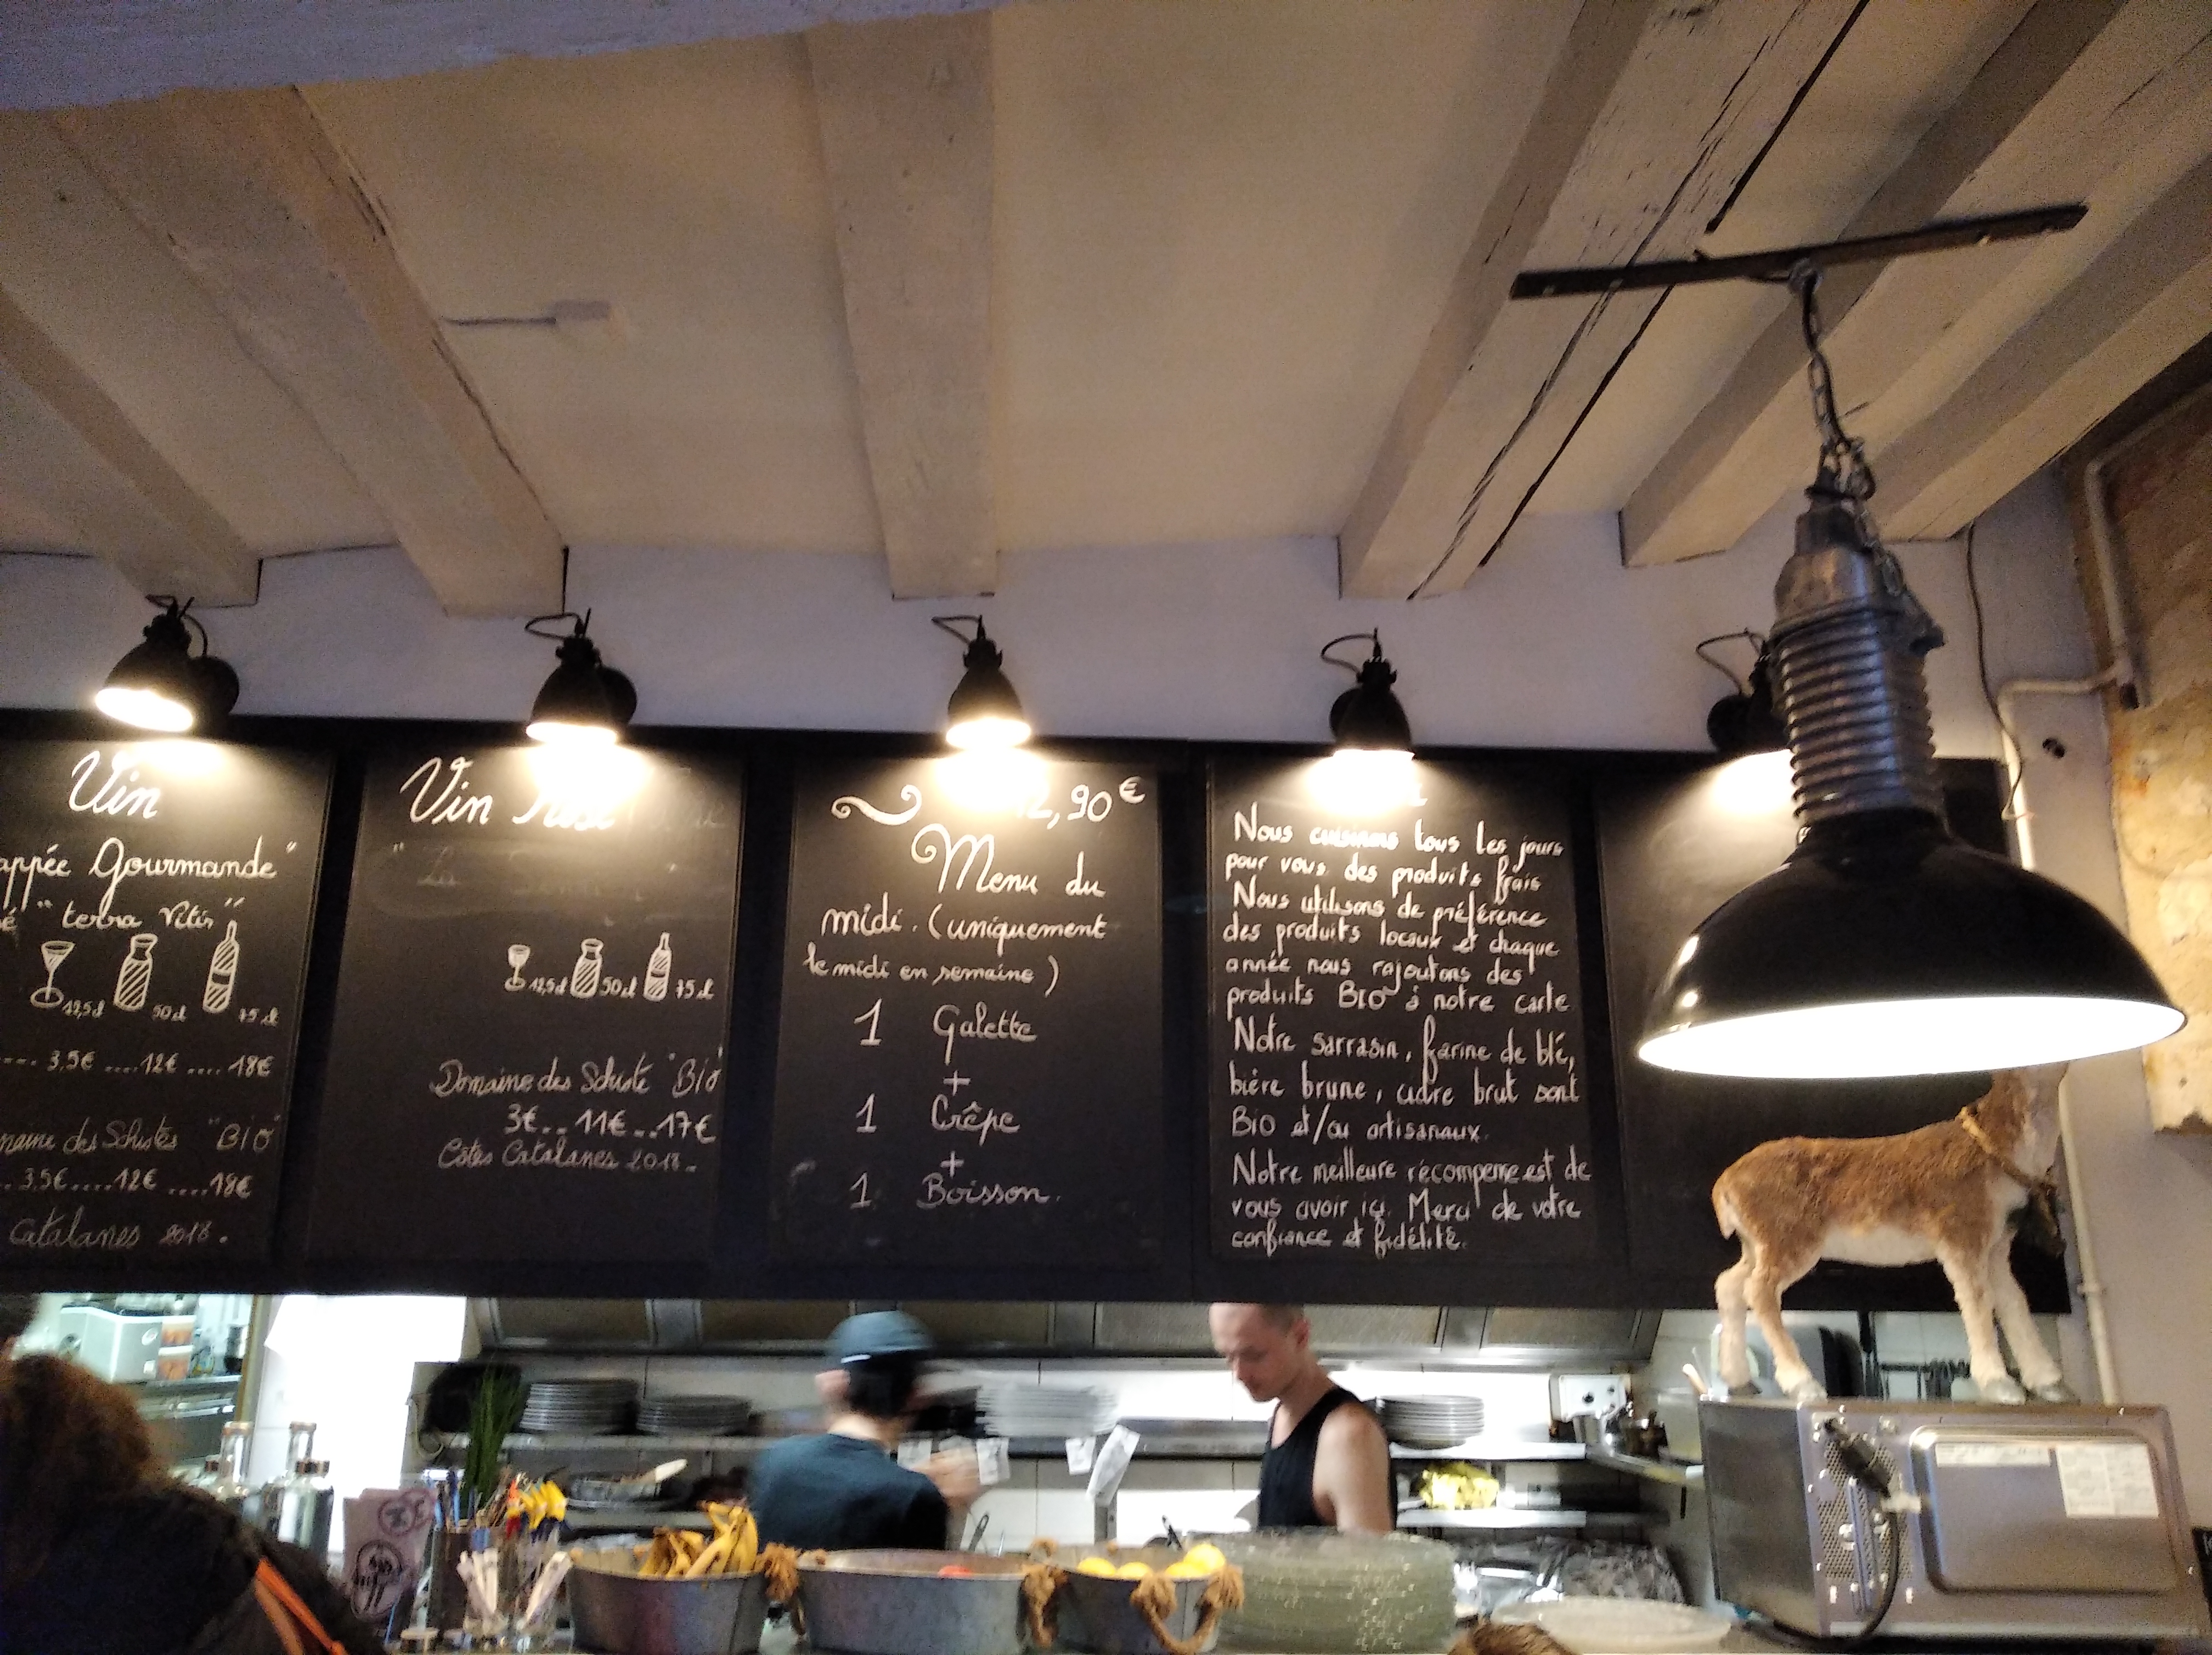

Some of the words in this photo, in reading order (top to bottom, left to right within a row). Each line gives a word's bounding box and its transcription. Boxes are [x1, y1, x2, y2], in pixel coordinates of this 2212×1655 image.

[69, 750, 161, 819] Vin
[399, 756, 493, 825] Vin
[911, 823, 1038, 894] Menu
[1064, 851, 1107, 898] du
[1233, 801, 1294, 843] Nous
[1414, 818, 1461, 854] tous
[1475, 819, 1508, 857] les
[1511, 835, 1566, 874] jours
[1226, 852, 1269, 880] pour
[1280, 857, 1328, 877] vous
[1344, 852, 1379, 885] des
[1391, 856, 1483, 900] produits
[1493, 854, 1543, 906] frais
[1233, 874, 1291, 910] Nous
[1300, 883, 1386, 919] utilisons
[1396, 890, 1426, 920] de
[1431, 889, 1549, 939] préférence
[803, 941, 829, 976] le
[832, 954, 890, 980] midi
[899, 965, 929, 981] en
[1222, 910, 1263, 945] des
[1275, 912, 1362, 958] produits
[1379, 919, 1443, 949] locaux
[1452, 926, 1480, 955] et
[1488, 928, 1560, 975] chaque
[1225, 948, 1292, 974] année
[1307, 955, 1352, 977] nous
[1372, 954, 1472, 997] rajoutons
[1486, 957, 1524, 987] des
[1227, 975, 1315, 1023] produits
[1433, 983, 1497, 1014] notre
[1514, 980, 1572, 1015] carte
[853, 997, 883, 1046] 1
[933, 1000, 1038, 1066] Galette
[1233, 1011, 1296, 1053] Notre
[1423, 1014, 1493, 1085] farine
[1499, 1027, 1527, 1066] de
[1229, 1060, 1285, 1097] bière
[1396, 1077, 1455, 1106] cidre
[1474, 1066, 1520, 1106] brut
[1533, 1072, 1581, 1104] sont
[855, 1093, 878, 1133] 1
[932, 1093, 1021, 1147] Crêpe
[849, 1171, 873, 1209] 1
[1232, 1147, 1303, 1186] Notre
[1312, 1145, 1397, 1184] meilleure
[1522, 1147, 1556, 1183] est
[1564, 1144, 1593, 1182] de
[1231, 1196, 1283, 1220] vous
[1295, 1194, 1350, 1221] avoir
[1408, 1187, 1471, 1224] Merci
[1491, 1187, 1524, 1222] de
[1531, 1183, 1582, 1220] votre
[1231, 1217, 1333, 1258] confiance
[1342, 1216, 1365, 1249] et
